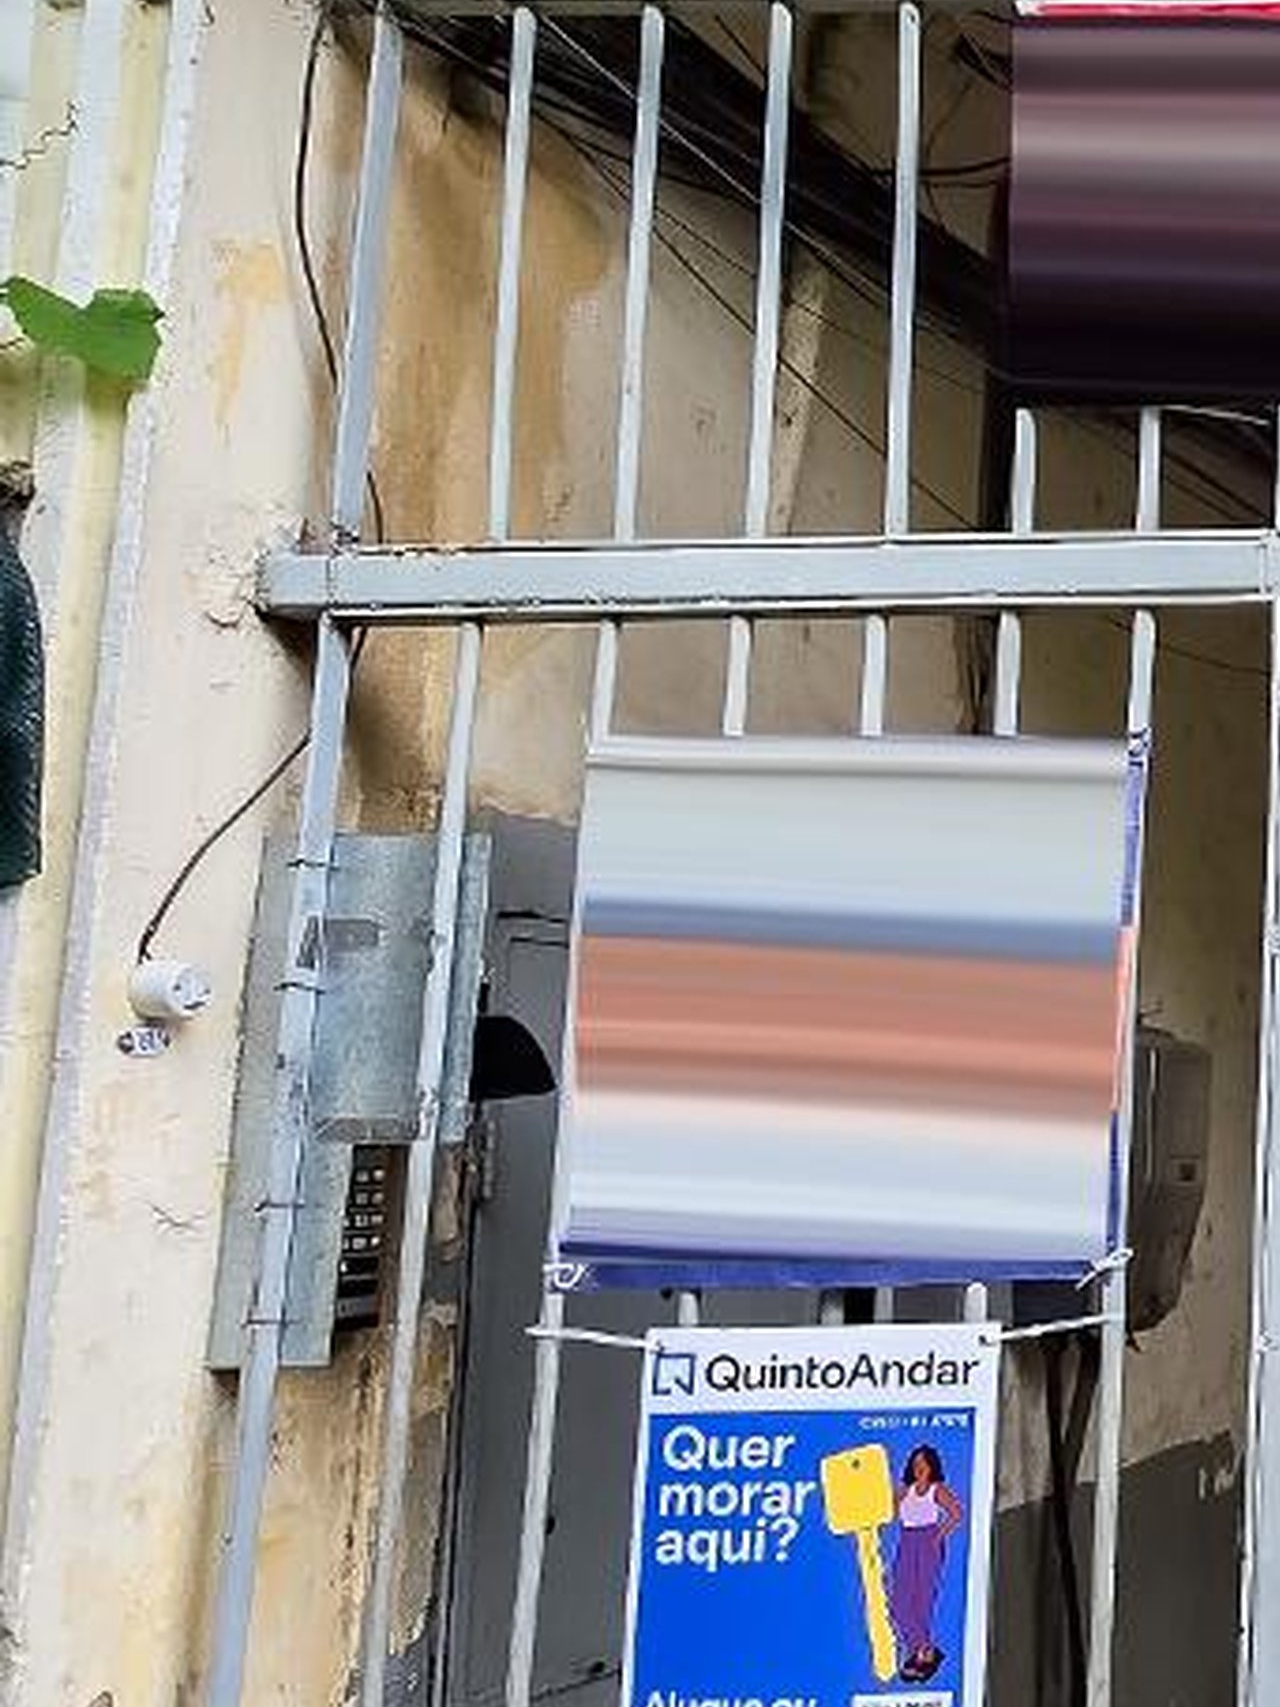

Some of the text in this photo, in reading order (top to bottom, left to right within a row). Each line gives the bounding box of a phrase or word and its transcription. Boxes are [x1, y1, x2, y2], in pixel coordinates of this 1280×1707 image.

[704, 1351, 981, 1394] QuintoAndar
[662, 1425, 796, 1472] Quer
[657, 1478, 818, 1518] morar
[654, 1516, 799, 1573] aqui?
